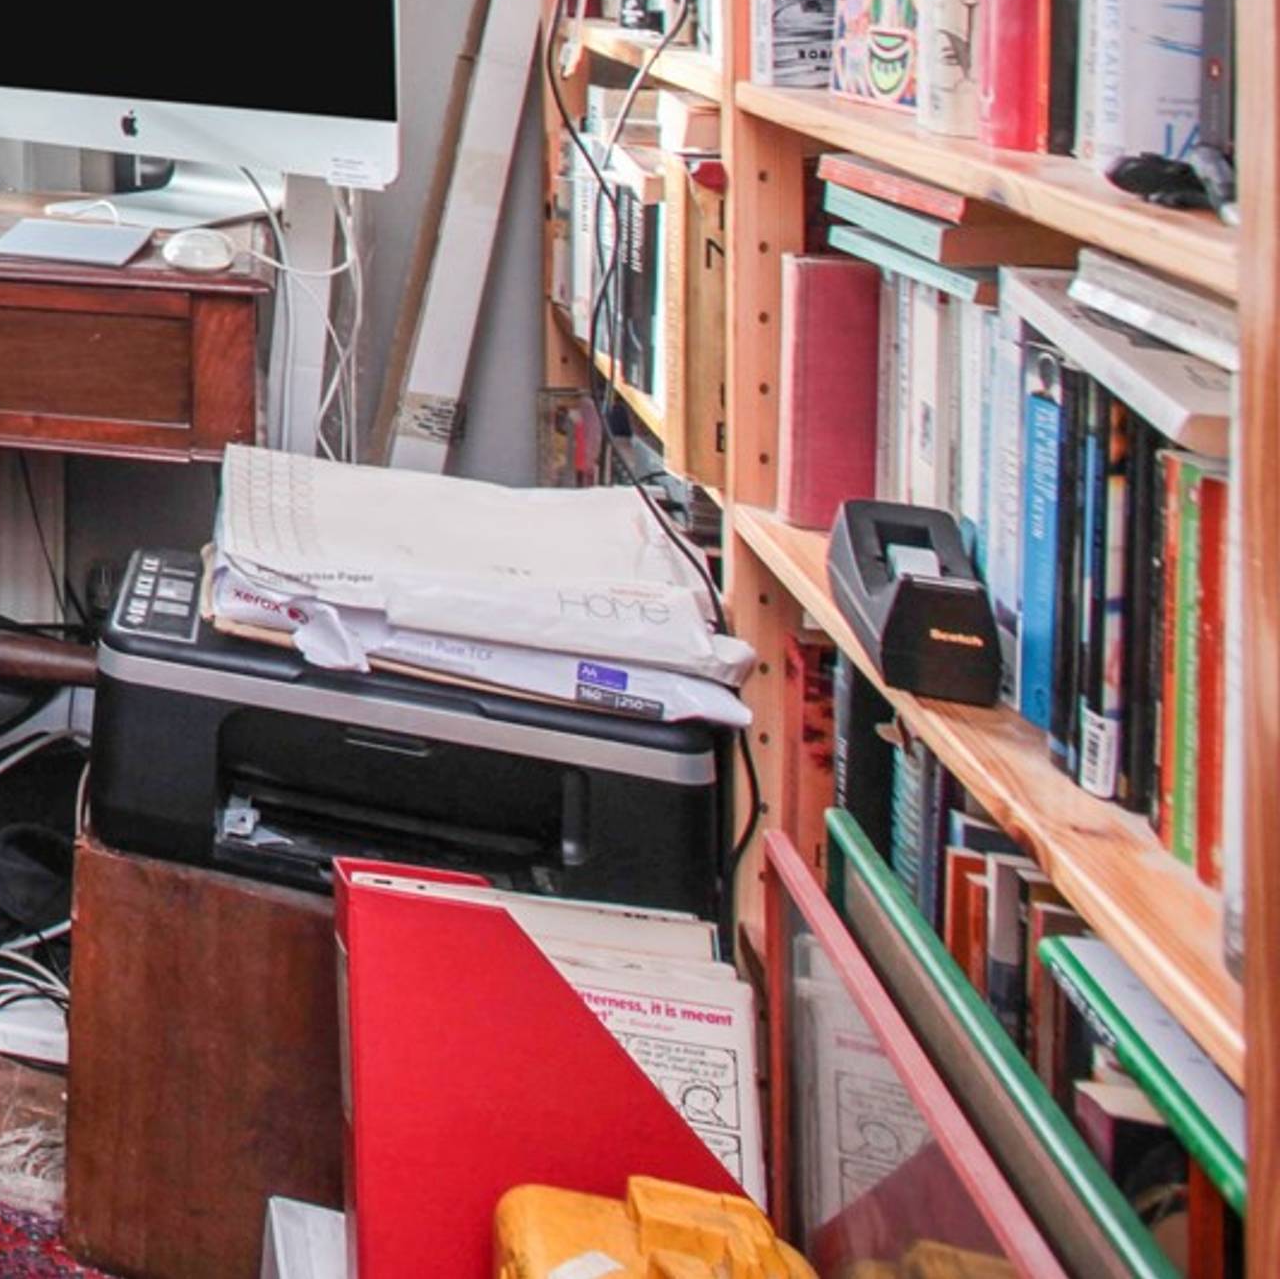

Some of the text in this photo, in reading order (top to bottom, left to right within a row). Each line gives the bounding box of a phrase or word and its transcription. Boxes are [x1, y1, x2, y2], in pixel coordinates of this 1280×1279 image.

[1031, 405, 1048, 540] TALK ABOUT KEVIN
[233, 588, 285, 615] xerox
[928, 627, 985, 648] Scotch
[619, 694, 647, 711] 250
[650, 1001, 733, 1027] it is meant
